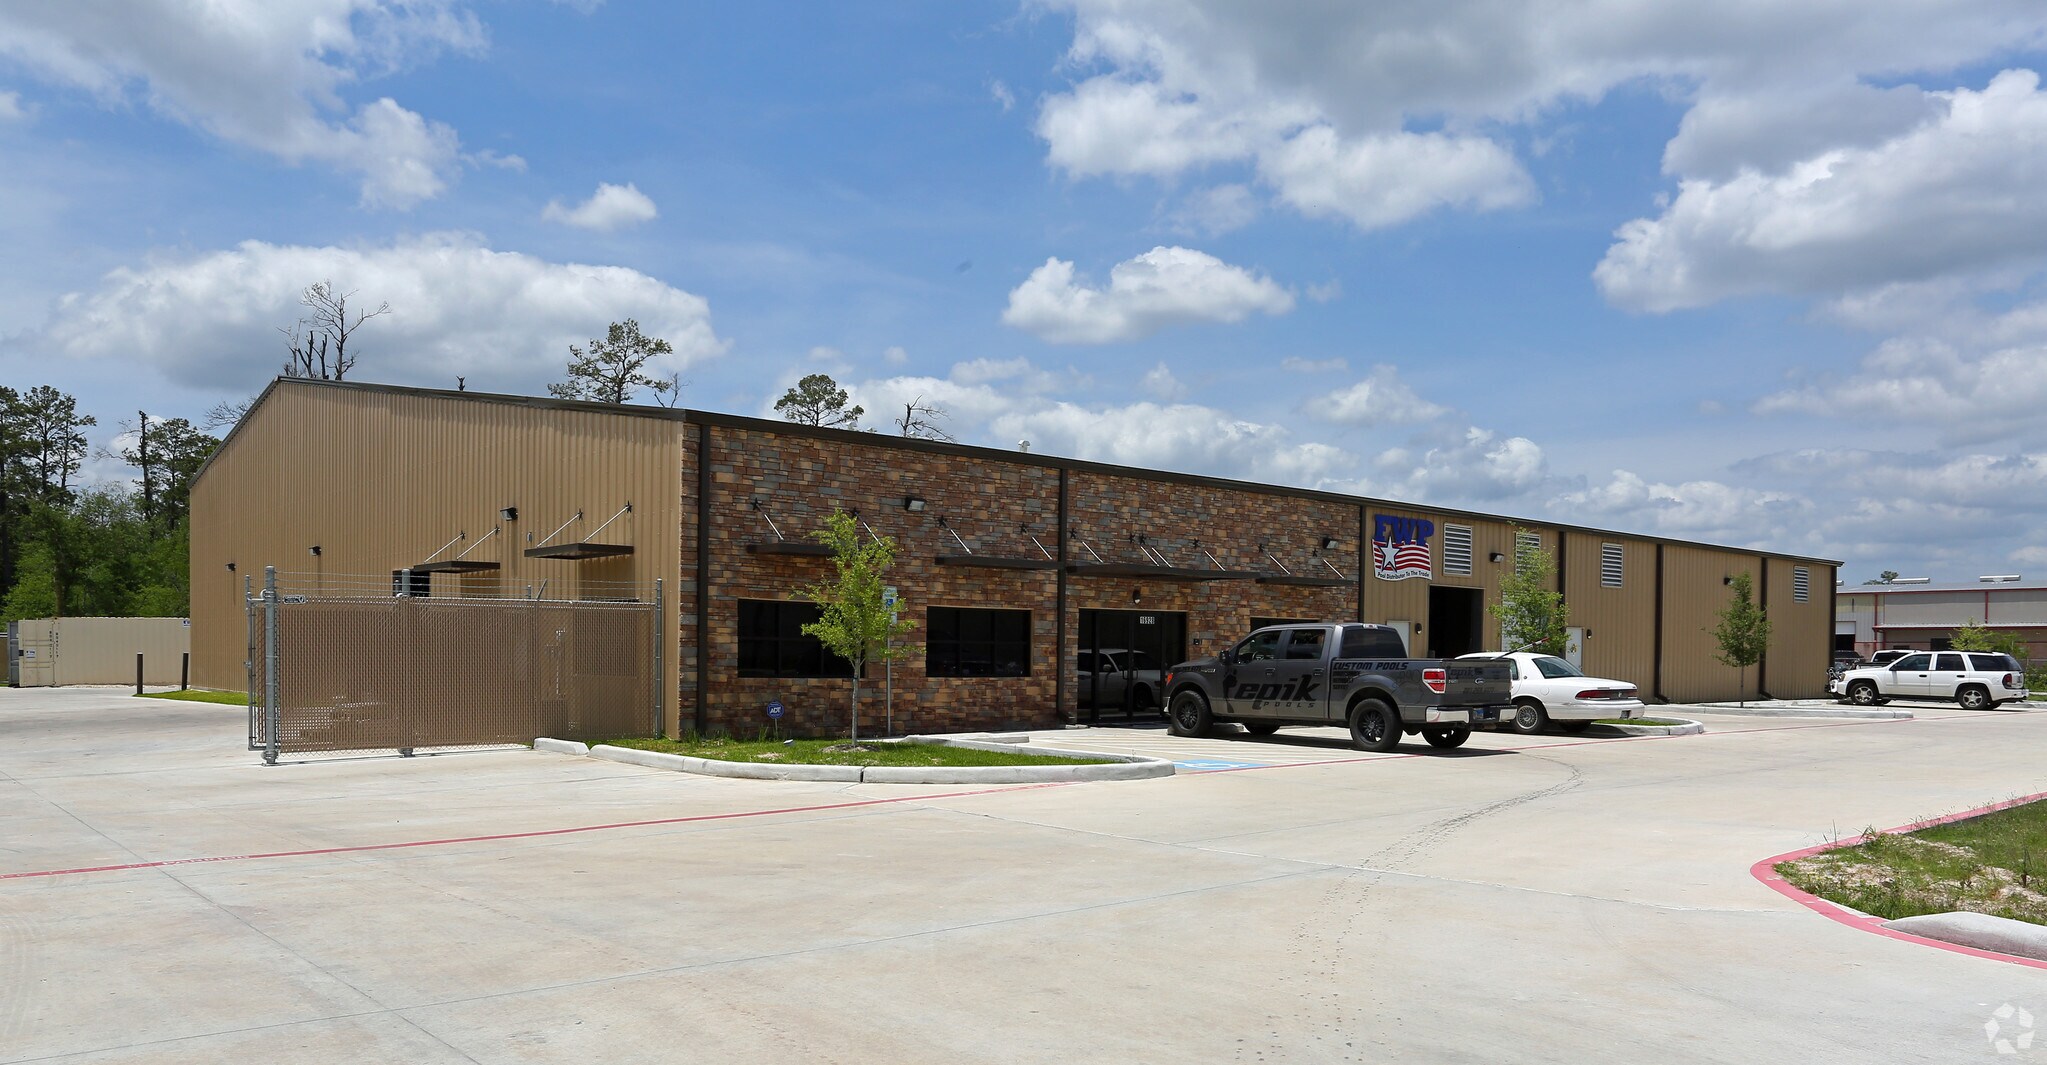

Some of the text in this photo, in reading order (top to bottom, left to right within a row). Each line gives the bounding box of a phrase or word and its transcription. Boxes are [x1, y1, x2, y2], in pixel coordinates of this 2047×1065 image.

[1333, 662, 1409, 670] CUSTOM POOLS
[1234, 674, 1320, 710] epik
[1263, 701, 1316, 709] POOLS
